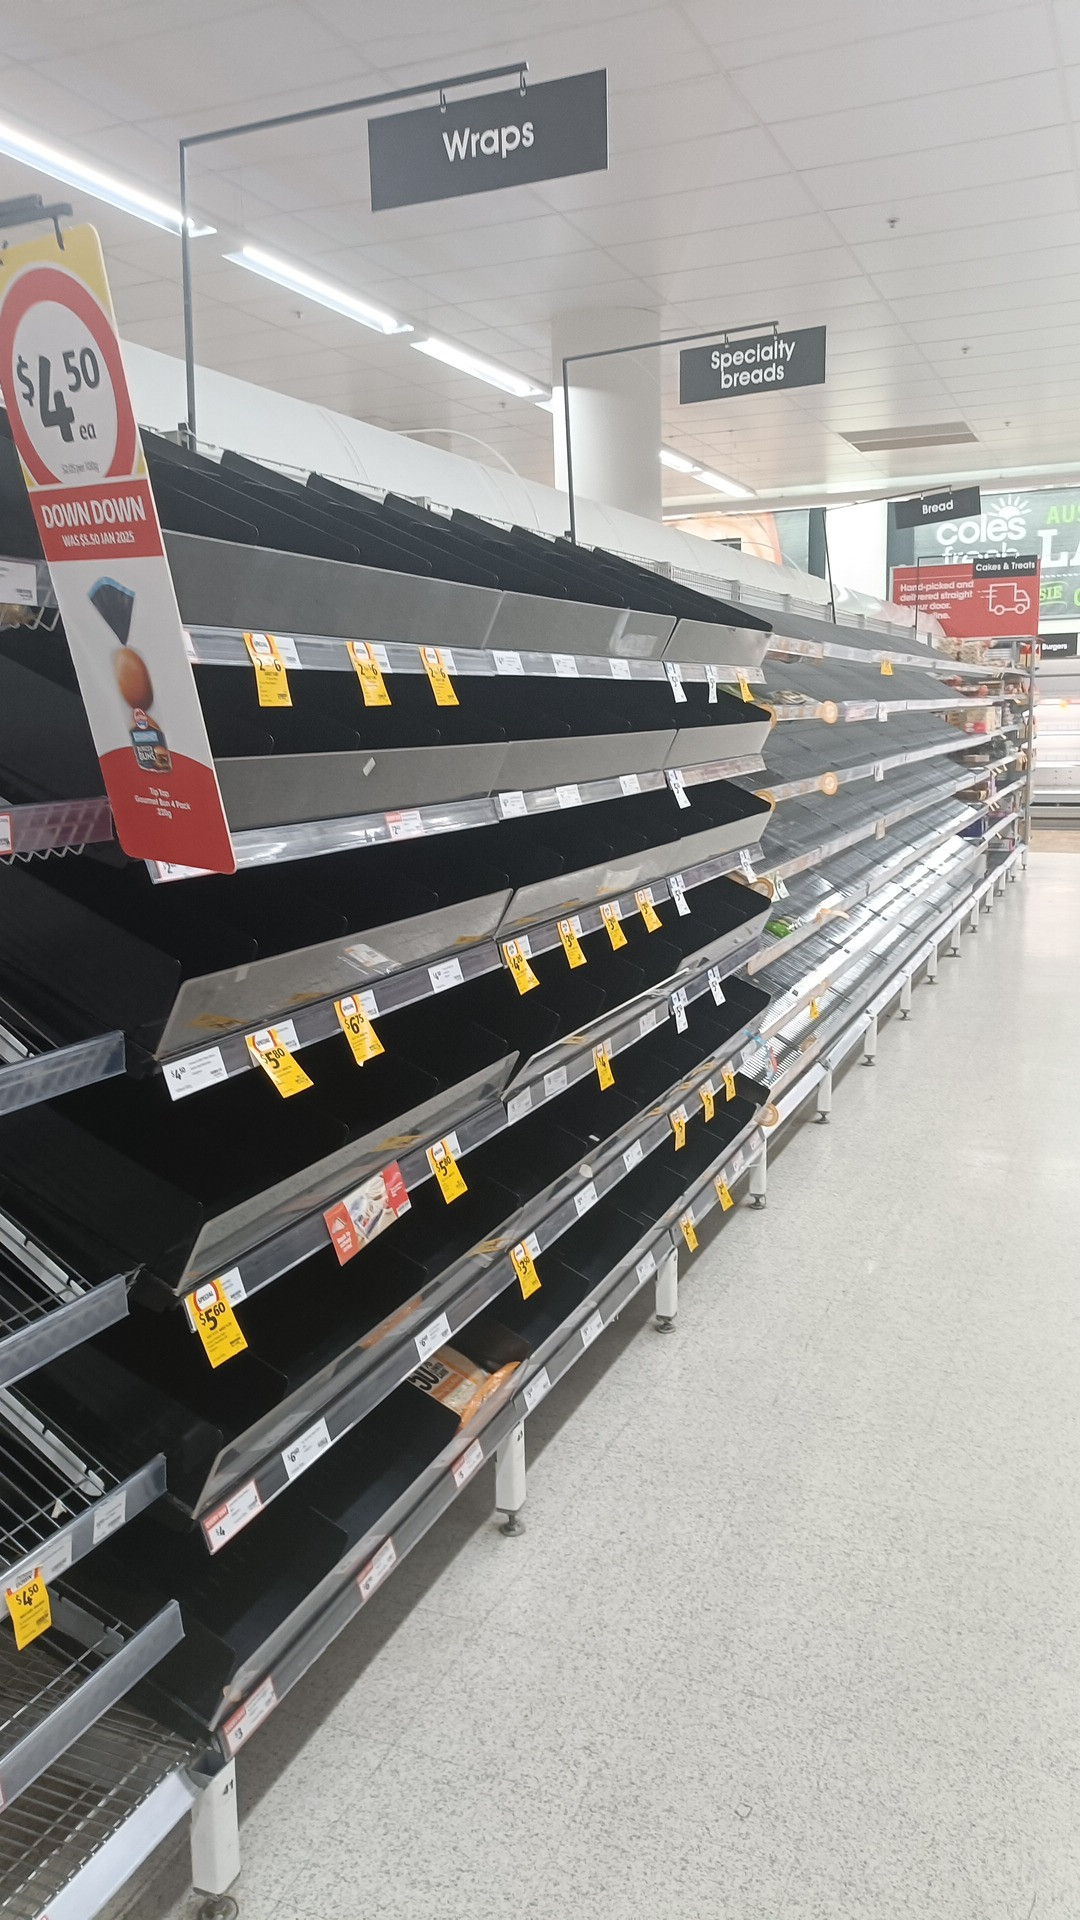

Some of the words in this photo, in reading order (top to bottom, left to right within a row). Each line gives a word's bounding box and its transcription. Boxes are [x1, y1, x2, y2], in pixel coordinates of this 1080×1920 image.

[442, 121, 535, 163] Wraps
[711, 339, 796, 371] Specialty
[721, 363, 785, 389] breads
[79, 422, 97, 441] ea
[41, 501, 91, 529] DOWN
[90, 495, 146, 525] DOWN
[922, 500, 954, 515] Bread
[937, 514, 1026, 545] coles
[61, 534, 80, 547] WAS
[100, 531, 116, 545] JAN
[115, 530, 135, 543] 2025
[975, 562, 1001, 572] Cakes
[1003, 561, 1010, 570] &
[1011, 560, 1036, 570] Treats
[900, 582, 955, 592] Hand-picked
[956, 581, 974, 589] and
[940, 590, 973, 600] straight
[1042, 643, 1068, 651] Burgers
[138, 750, 156, 761] BUNS
[197, 1291, 214, 1304] SPECIAL
